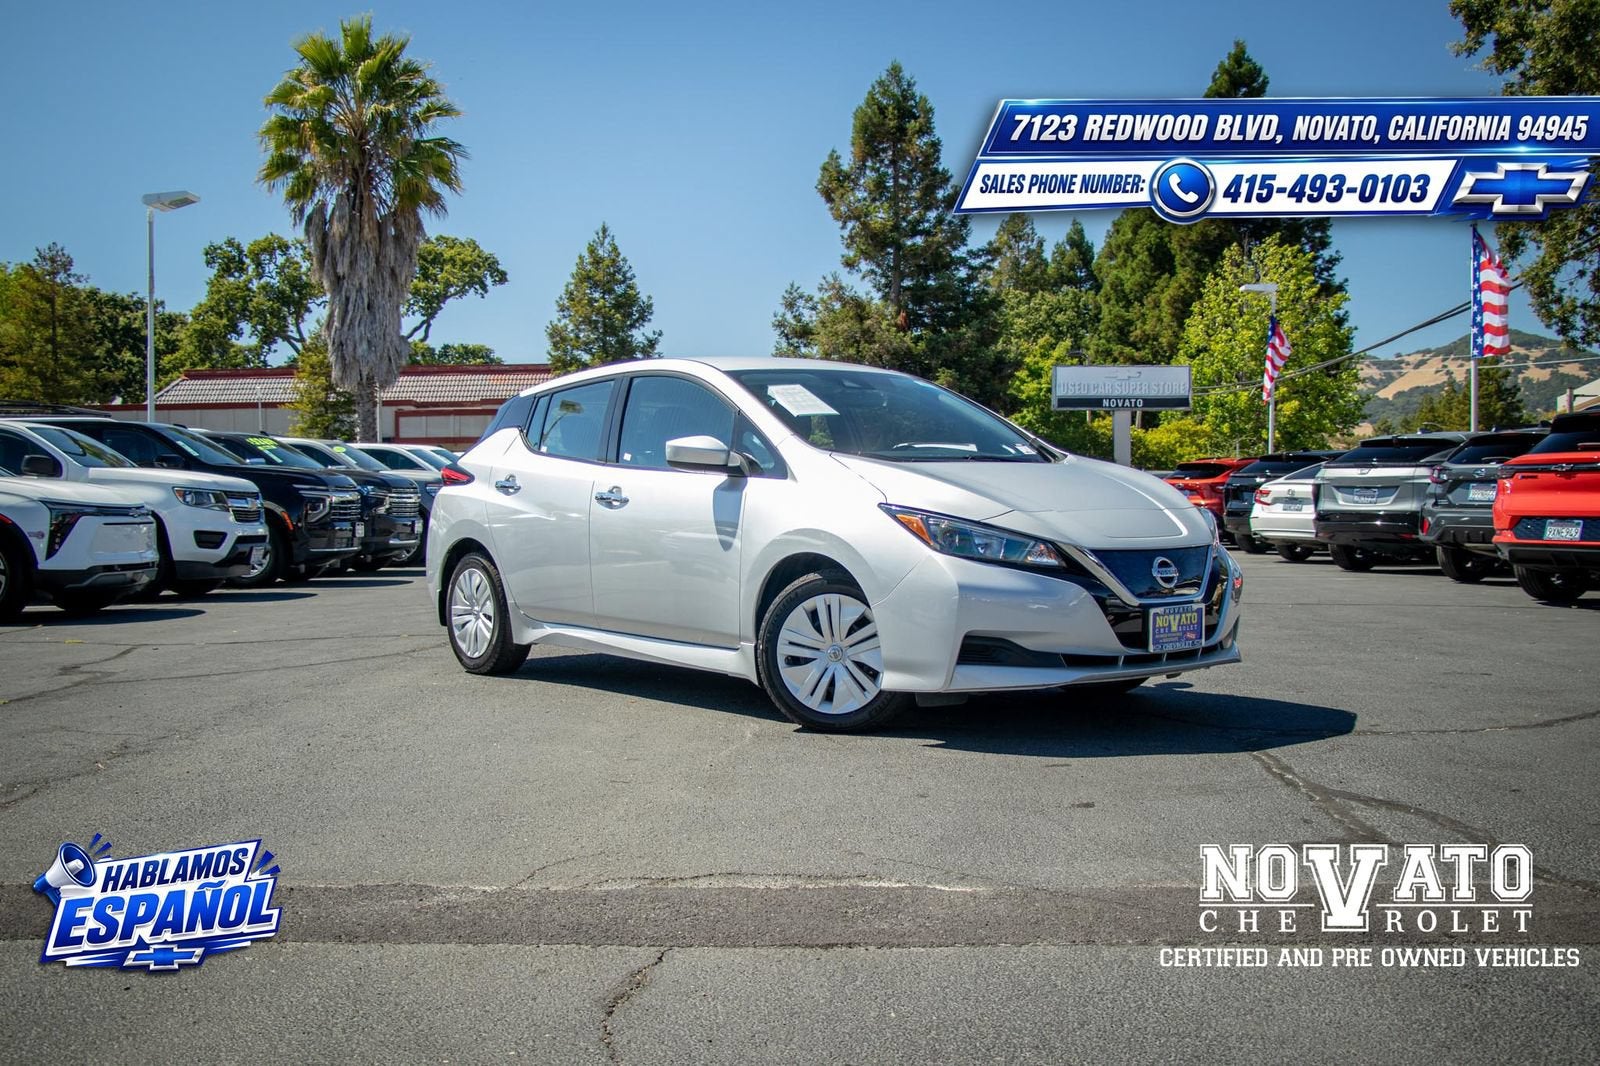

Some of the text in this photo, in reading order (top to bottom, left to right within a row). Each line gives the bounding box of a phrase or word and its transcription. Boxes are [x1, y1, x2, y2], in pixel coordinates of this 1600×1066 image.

[1061, 382, 1186, 394] USED CAR SUPER STORE
[1102, 398, 1144, 408] NOVATO
[1156, 612, 1198, 632] NOVATO
